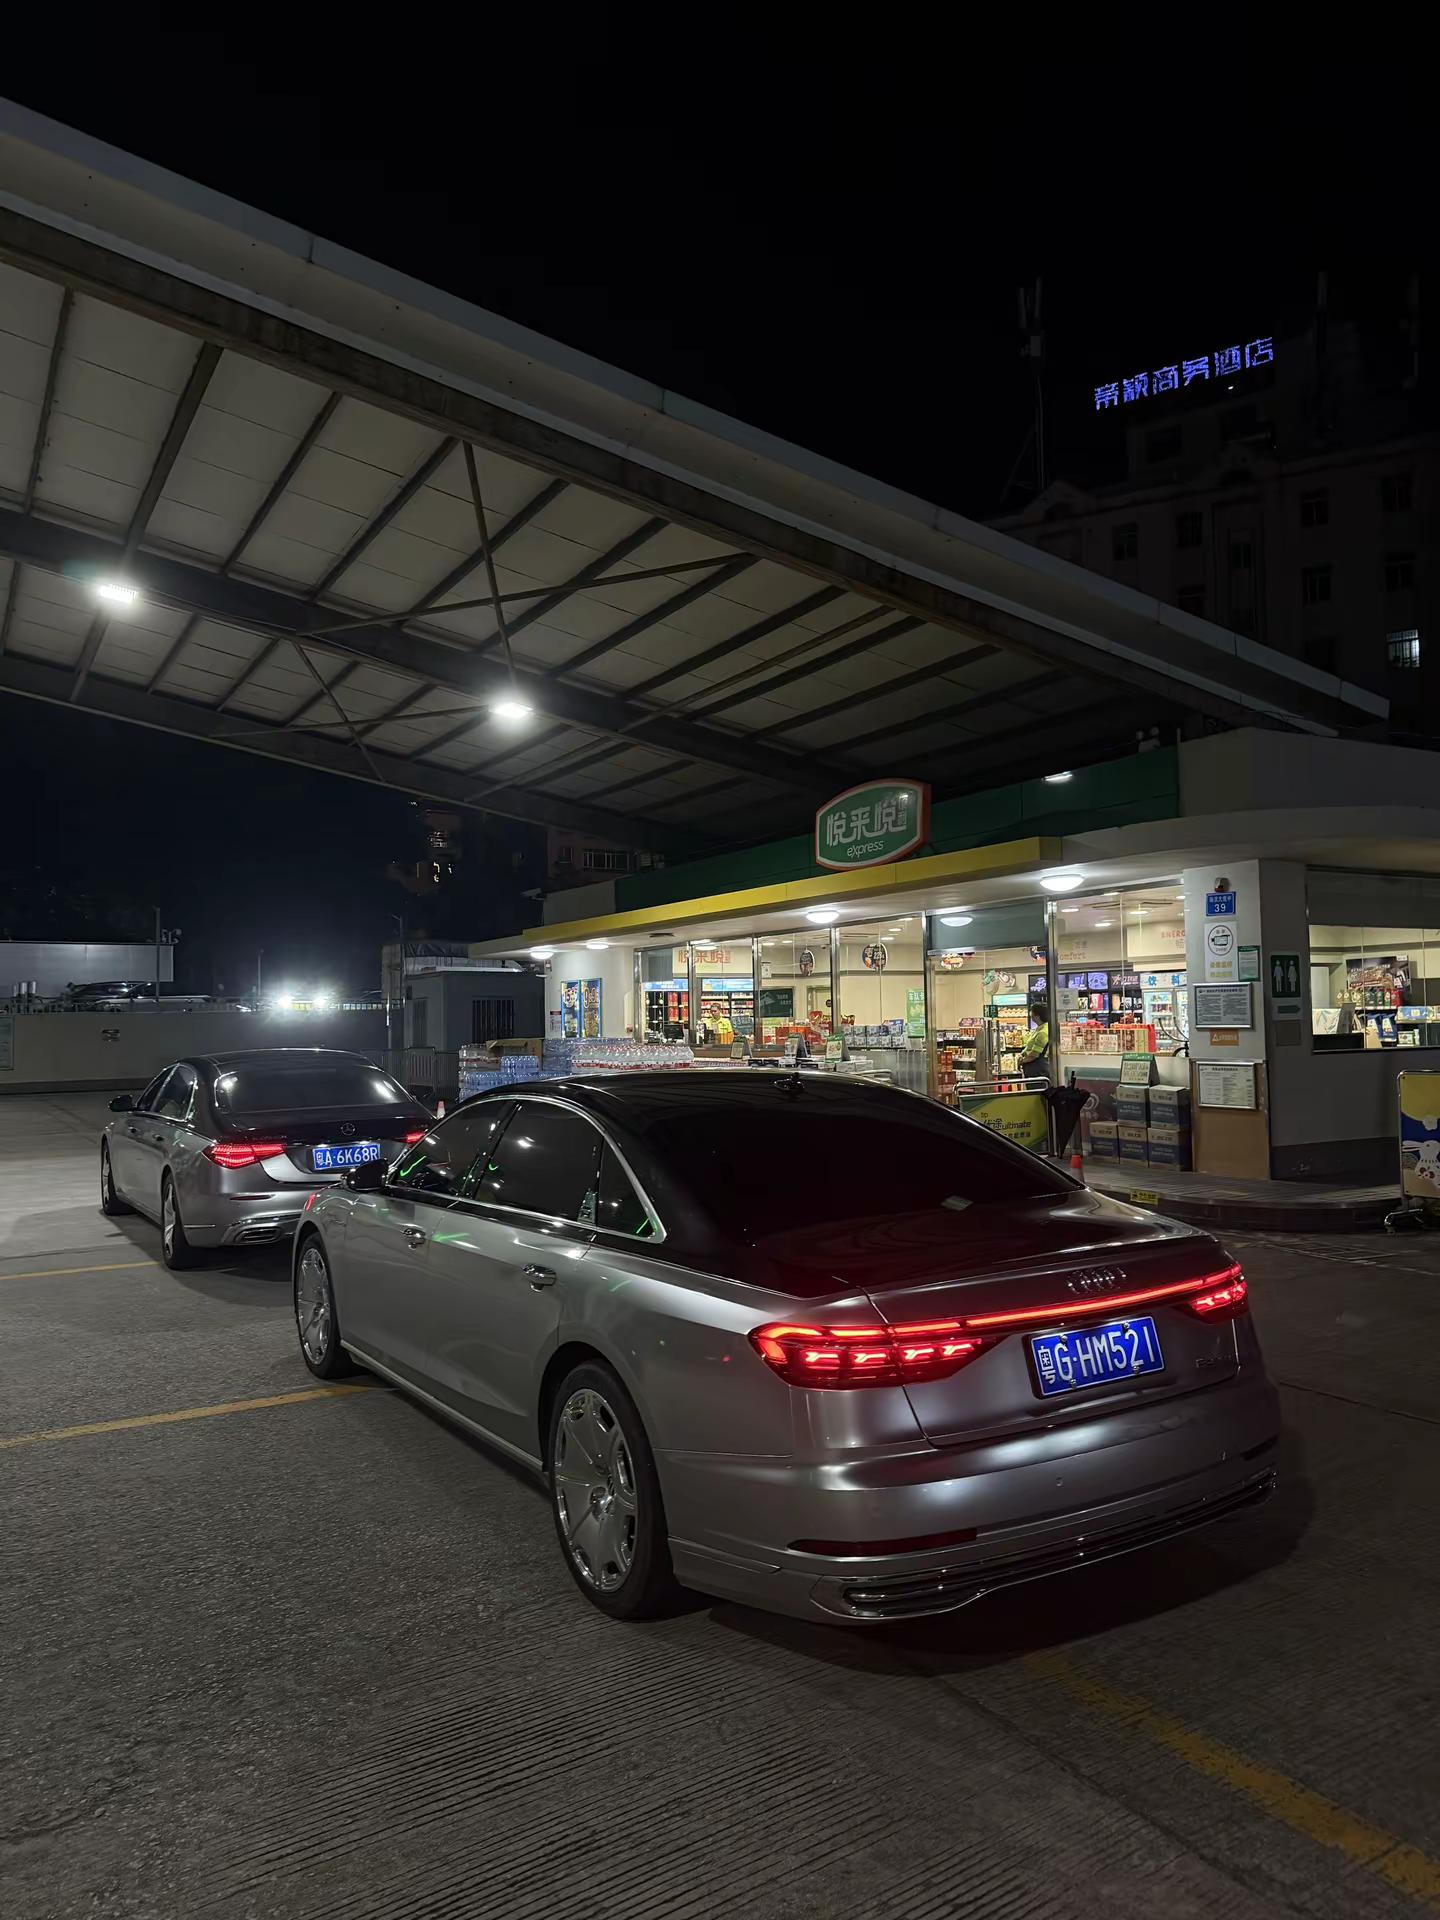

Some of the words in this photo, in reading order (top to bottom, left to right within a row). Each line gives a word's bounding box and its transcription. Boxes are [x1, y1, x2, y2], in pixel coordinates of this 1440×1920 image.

[846, 840, 884, 858] express
[1214, 903, 1226, 913] 39
[1037, 1325, 1156, 1385] 粤G·HM521
